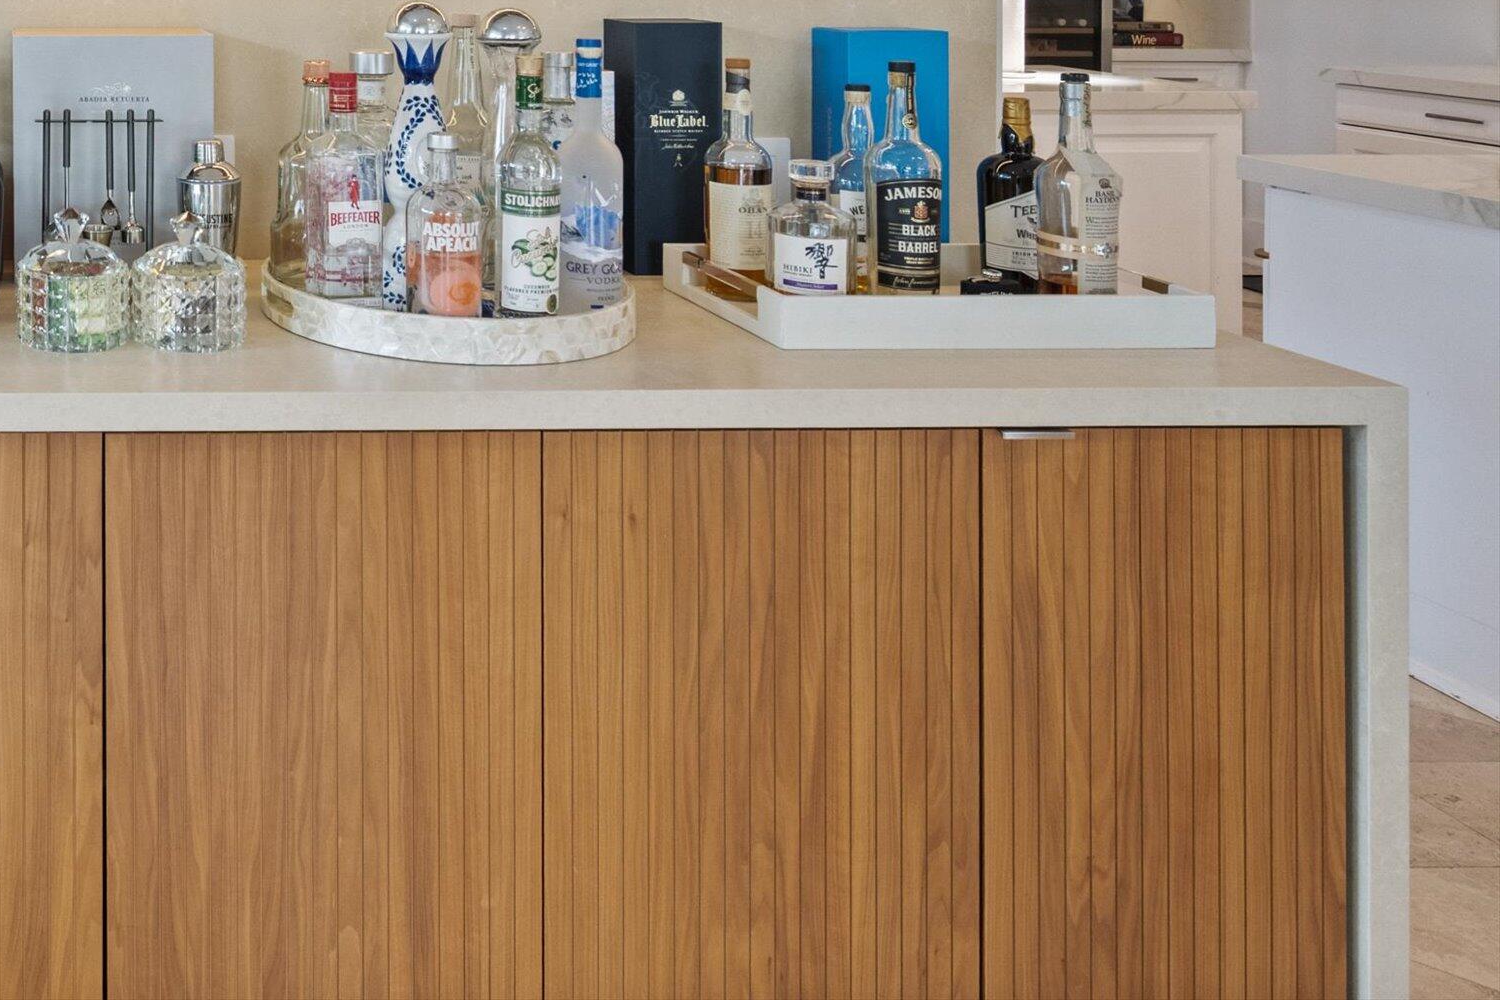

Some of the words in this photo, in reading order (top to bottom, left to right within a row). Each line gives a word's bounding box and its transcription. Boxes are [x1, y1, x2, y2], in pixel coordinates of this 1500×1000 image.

[1130, 34, 1157, 46] Wine
[649, 114, 676, 128] Blue
[675, 114, 707, 128] Label
[329, 210, 381, 227] BEEFEATER
[422, 220, 480, 237] ABSOLUT
[901, 224, 937, 237] BLACK
[426, 235, 478, 253] APEACH
[898, 240, 939, 253] BARREL
[565, 260, 598, 275] GREY
[782, 263, 813, 274] HIBIKI
